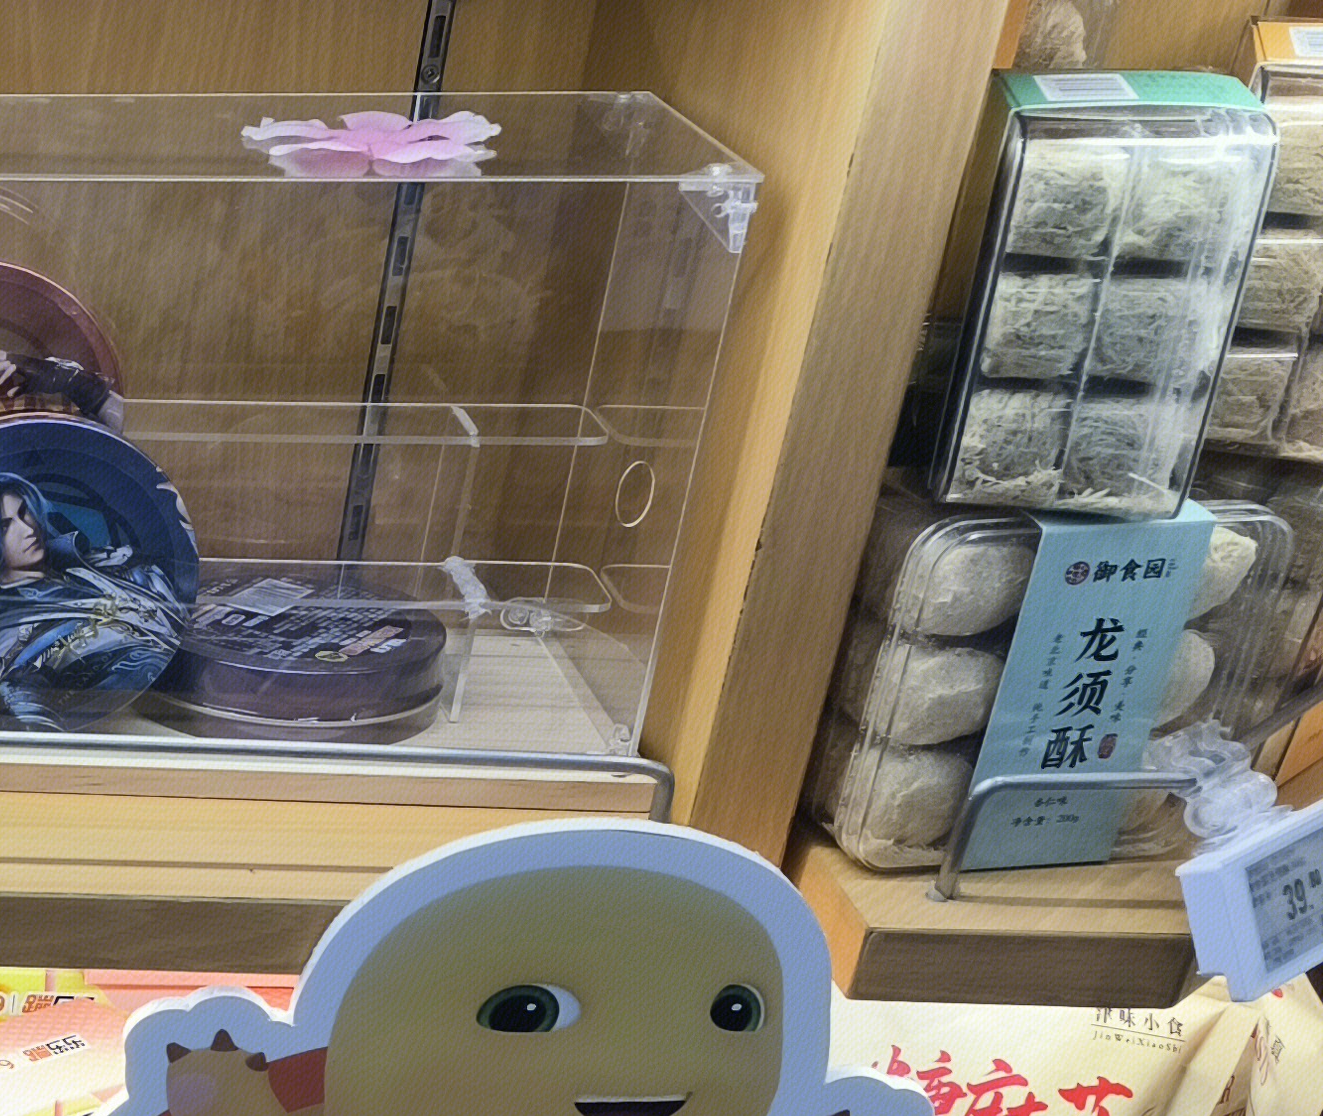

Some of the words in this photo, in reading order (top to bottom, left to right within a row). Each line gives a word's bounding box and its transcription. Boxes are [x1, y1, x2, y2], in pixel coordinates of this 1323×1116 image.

[1092, 558, 1167, 583] 御食园
[1041, 617, 1125, 770] 龙须酥
